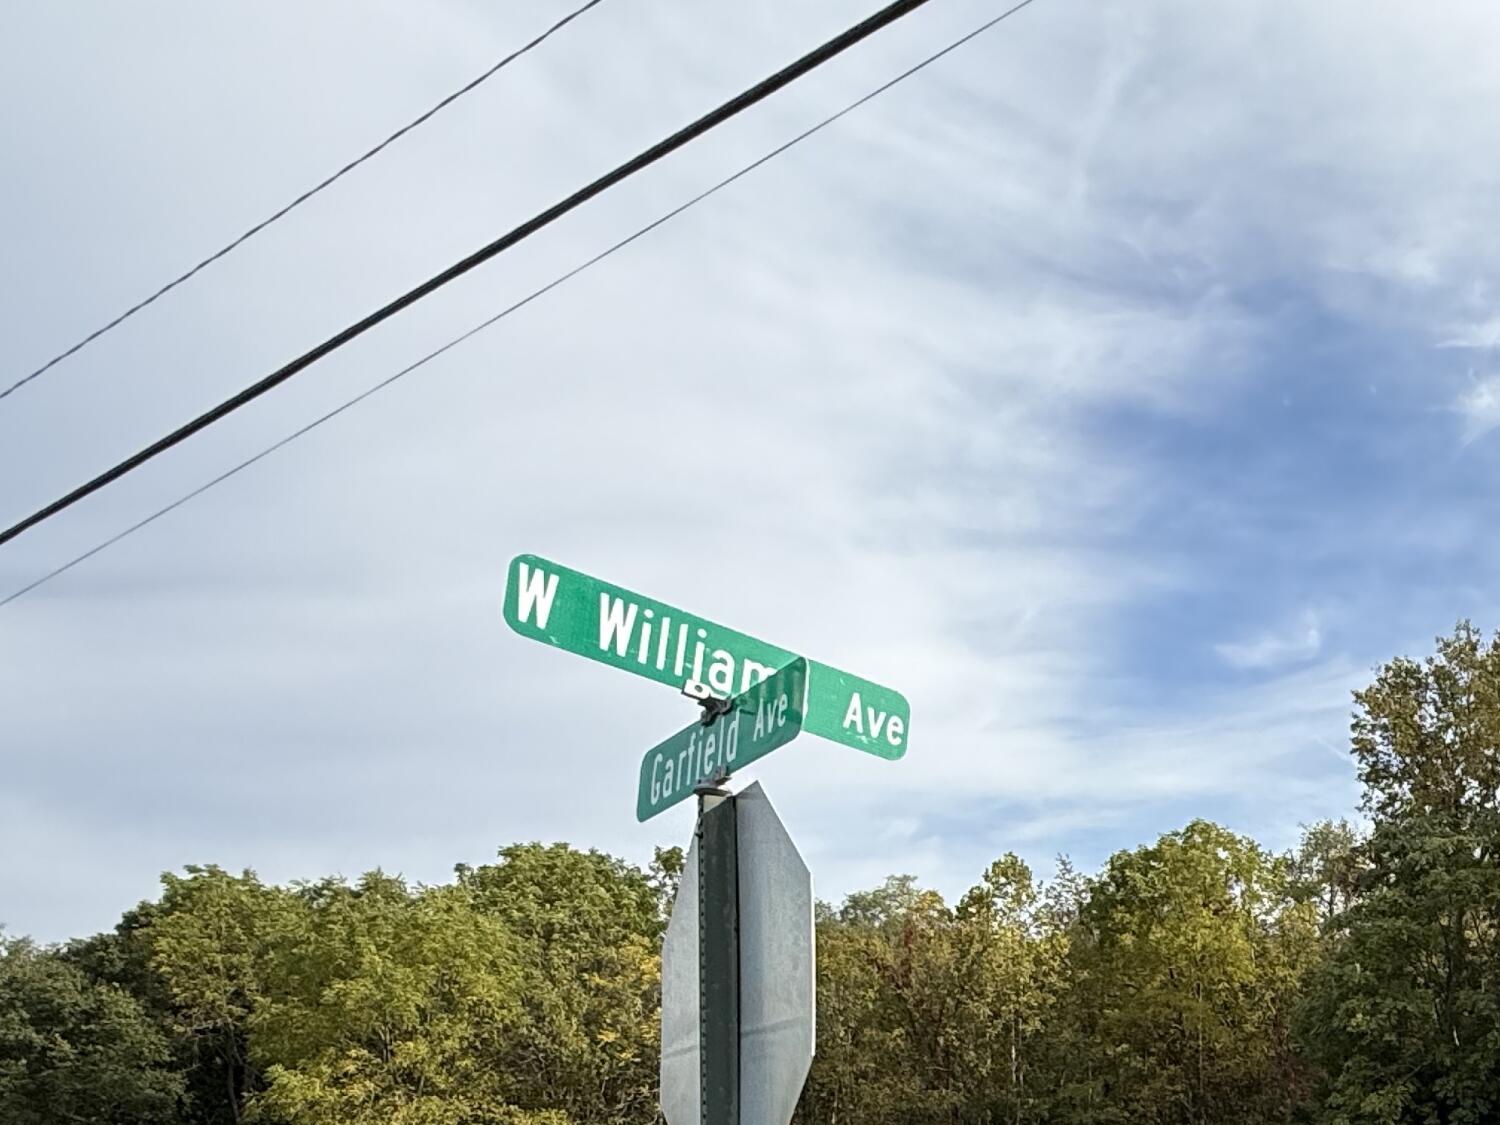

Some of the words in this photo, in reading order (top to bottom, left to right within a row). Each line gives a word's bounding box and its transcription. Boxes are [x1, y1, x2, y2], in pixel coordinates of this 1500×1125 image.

[517, 562, 560, 630] W
[843, 692, 905, 747] Ave
[650, 709, 740, 806] Garfield
[752, 690, 788, 742] Ave
